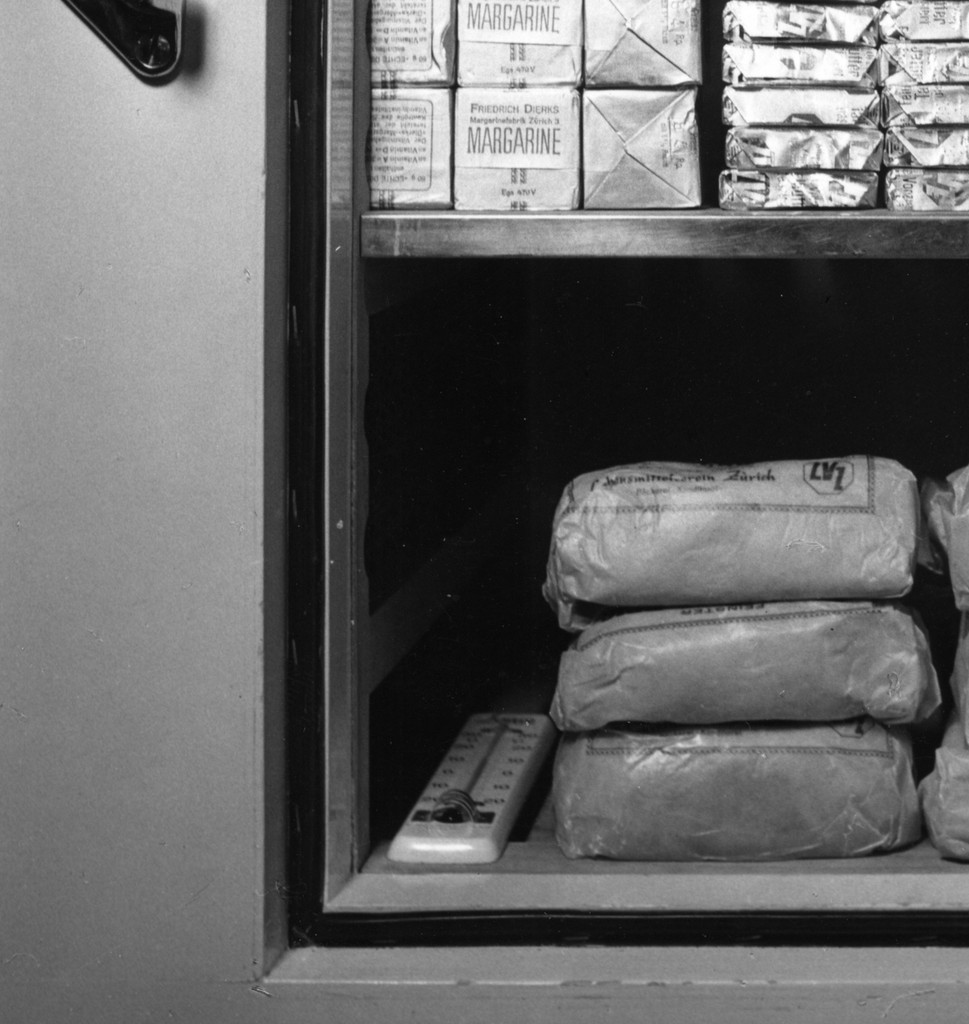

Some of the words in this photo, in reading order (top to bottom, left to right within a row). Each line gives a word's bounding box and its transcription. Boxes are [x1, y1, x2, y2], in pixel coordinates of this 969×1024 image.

[467, 2, 561, 34] MARGARINE
[470, 103, 520, 114] FRIEDRICH
[524, 103, 560, 114] DIERKS
[467, 126, 561, 155] MARGARINE
[724, 468, 776, 482] Zürich
